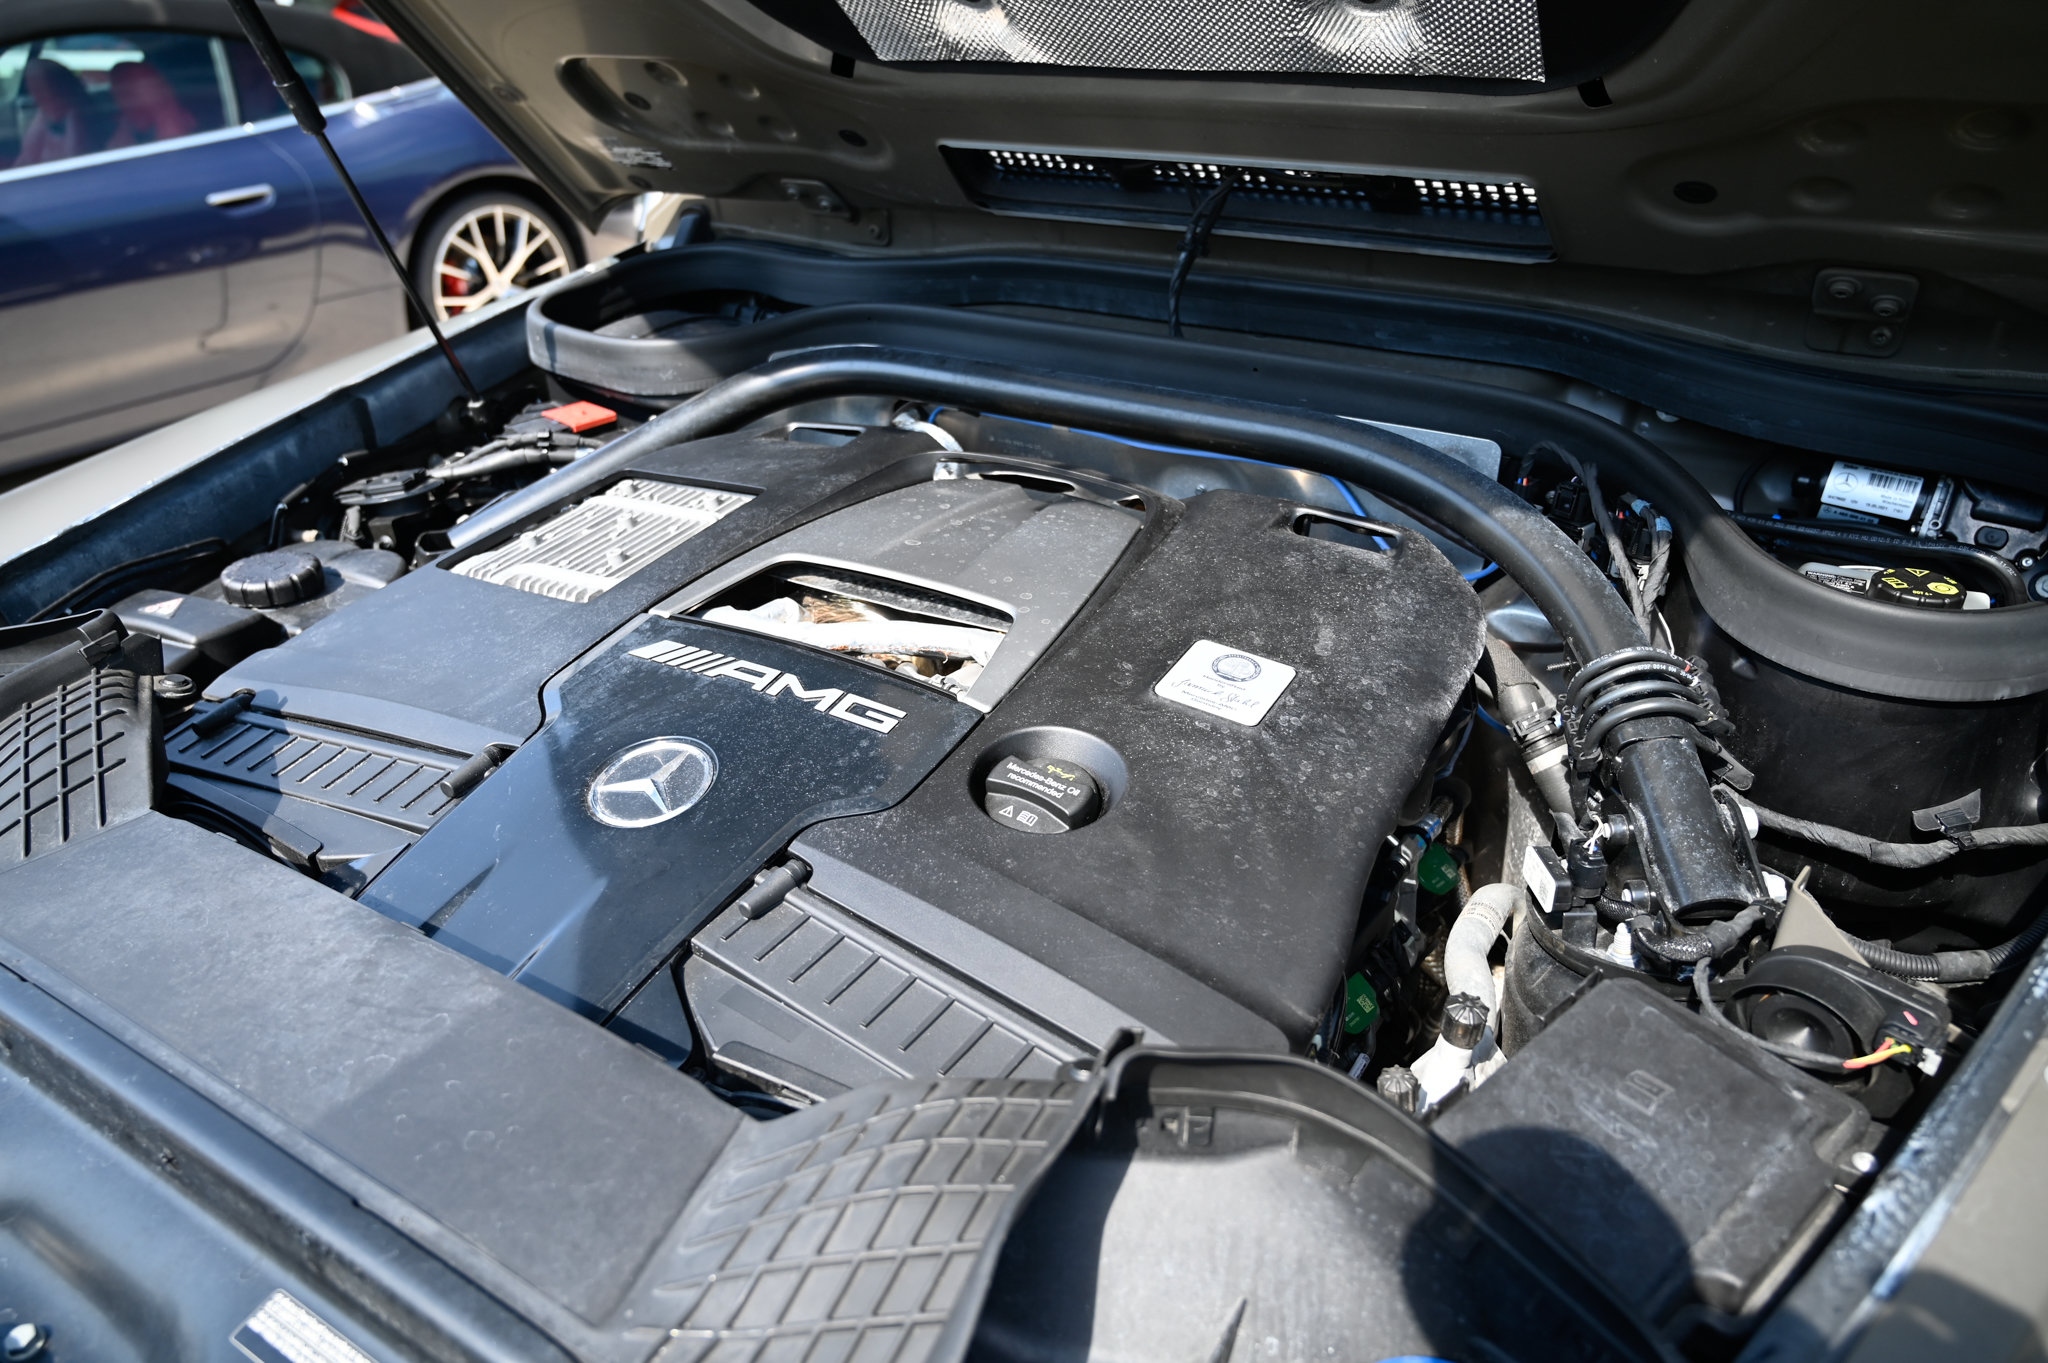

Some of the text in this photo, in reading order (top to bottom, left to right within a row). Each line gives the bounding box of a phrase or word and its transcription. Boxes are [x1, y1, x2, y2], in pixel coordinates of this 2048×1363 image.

[702, 655, 907, 735] AMG
[1006, 762, 1081, 796] Mercedes-Benz Oil
[1007, 771, 1064, 799] recommended
